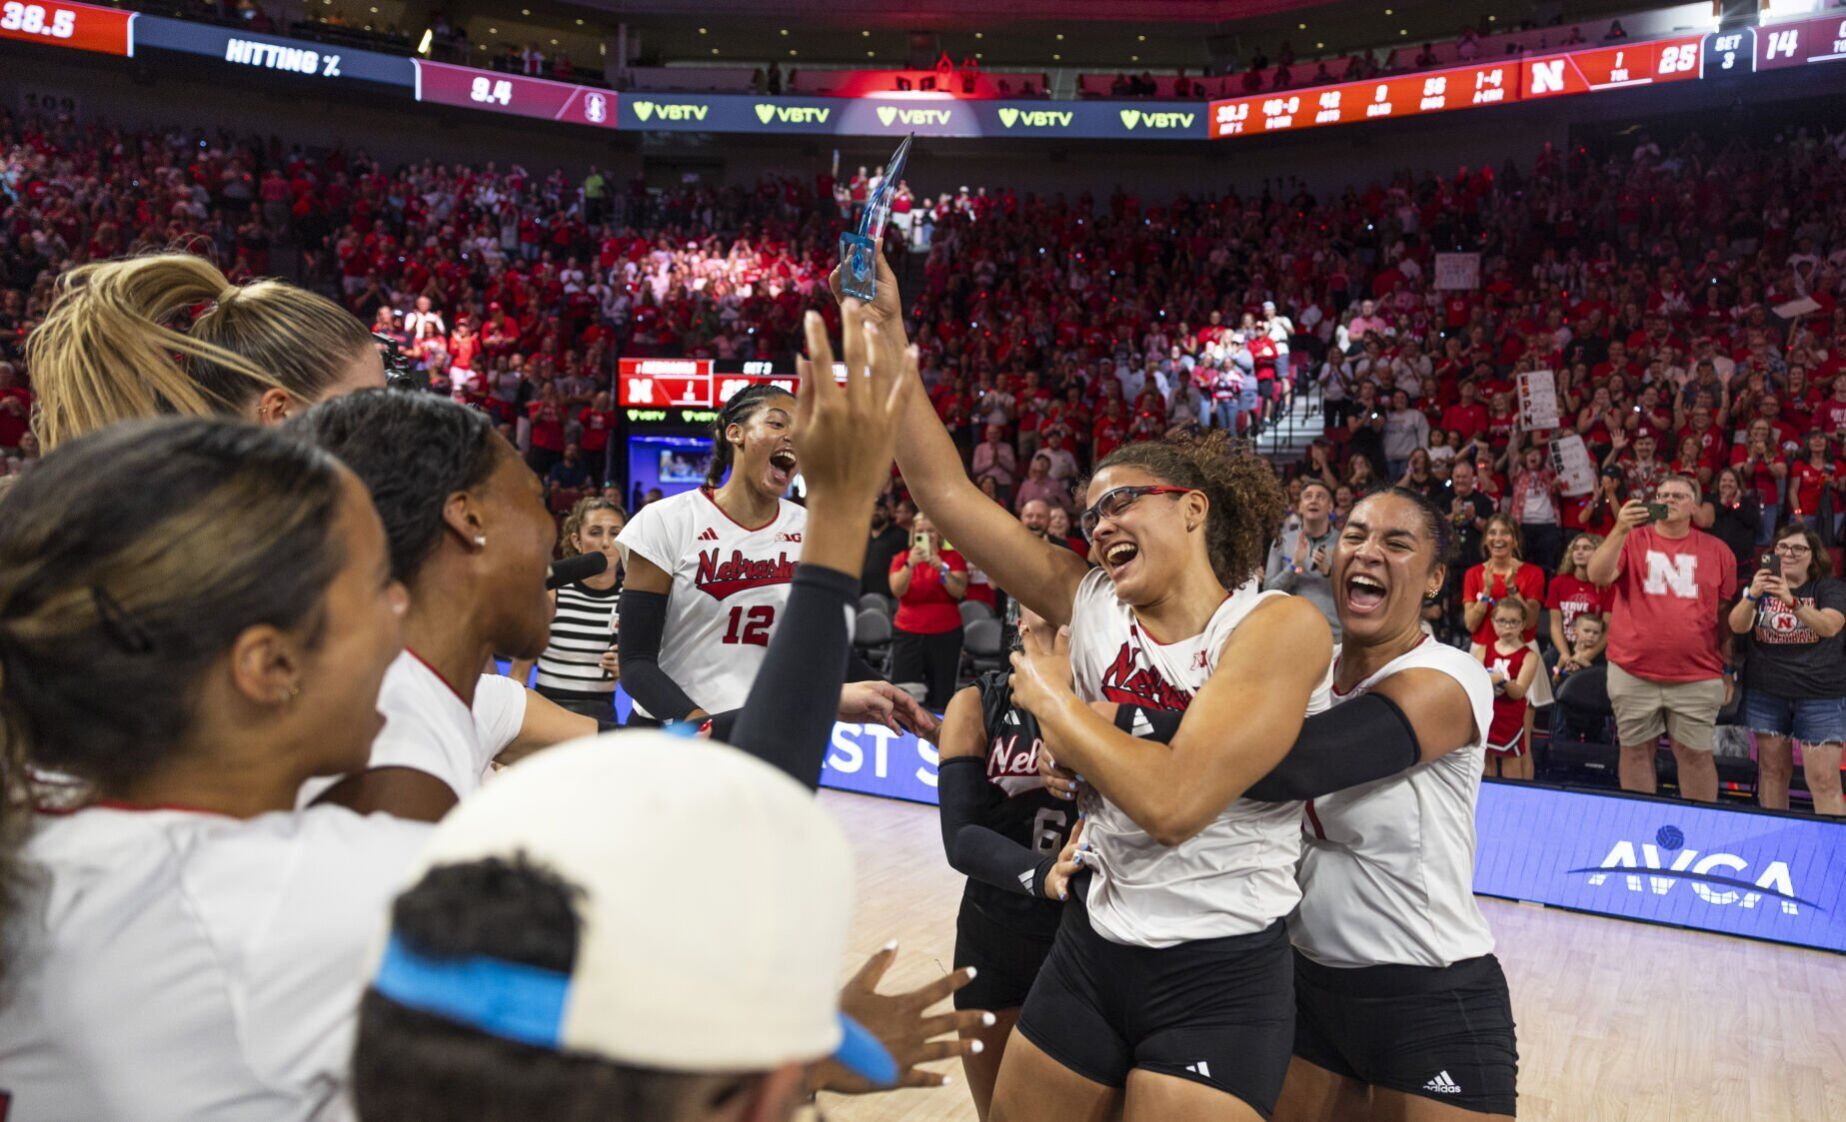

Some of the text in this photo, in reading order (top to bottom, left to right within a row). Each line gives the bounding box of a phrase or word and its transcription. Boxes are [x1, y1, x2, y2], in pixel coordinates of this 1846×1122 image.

[0, 1, 76, 38] 38.5
[226, 38, 341, 77] HITTING %
[1715, 34, 1742, 52] SET
[1766, 29, 1798, 60] 14
[1615, 51, 1624, 68] 1
[1658, 43, 1698, 74] 25
[1722, 51, 1735, 70] 3
[470, 76, 512, 106] 9.4
[1531, 60, 1565, 94] N
[655, 104, 708, 121] VBTV
[777, 106, 830, 123] VBTV
[898, 108, 951, 125] VBTV
[1020, 110, 1073, 127] VBTV
[1141, 112, 1195, 129] VBTV
[1644, 549, 1699, 599] N
[722, 605, 775, 648] 12
[1778, 617, 1792, 629] N
[828, 720, 902, 778] ST
[1031, 806, 1067, 858] 6
[1588, 840, 1799, 915] AVCA
